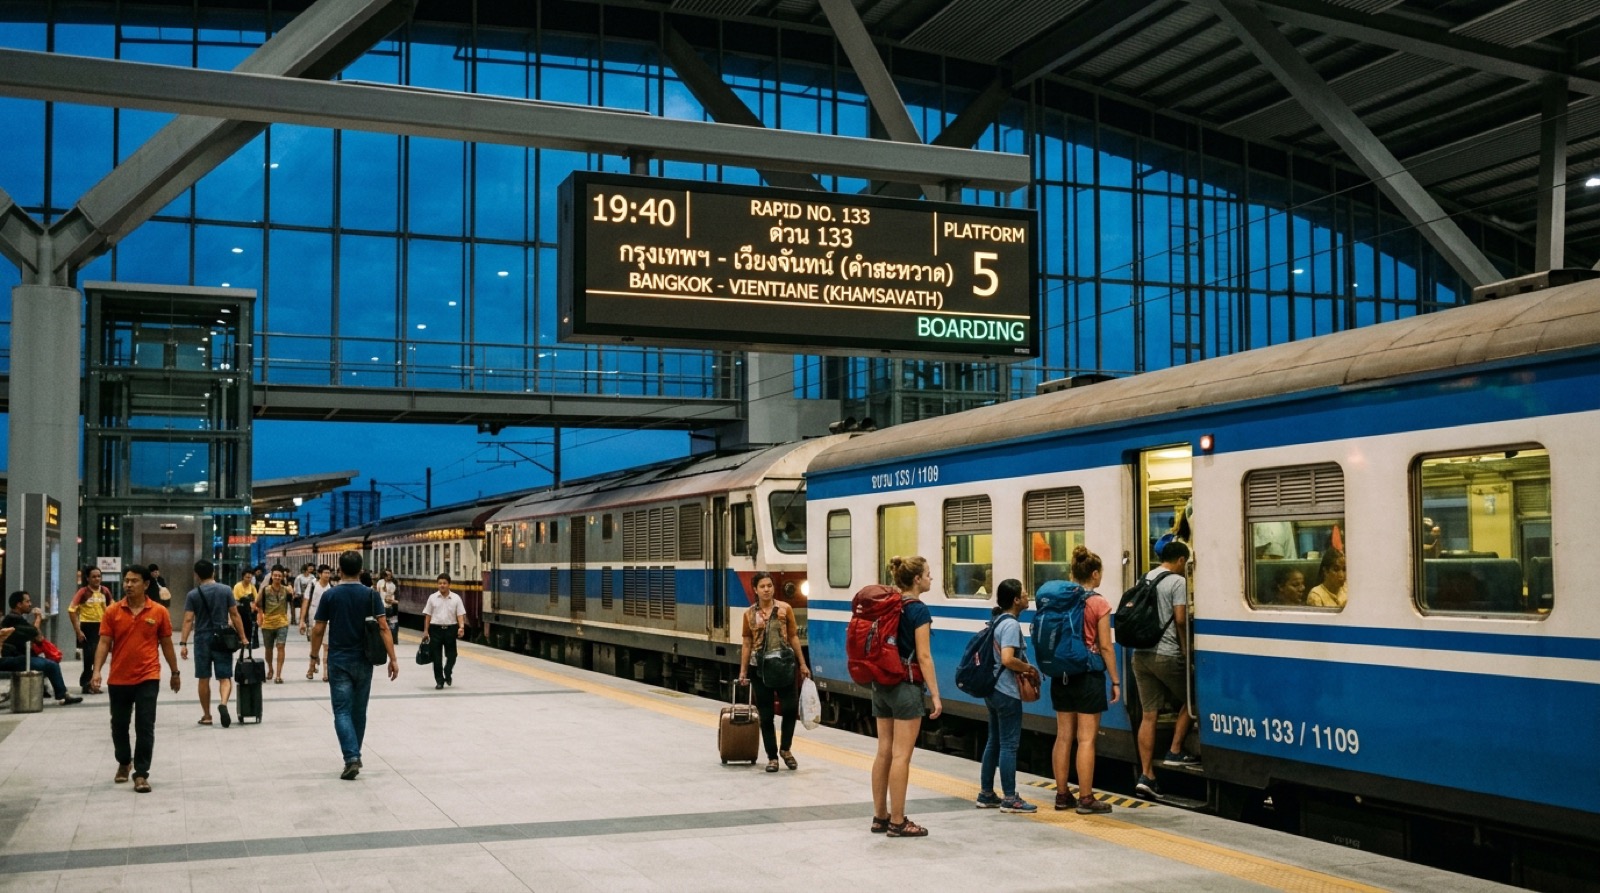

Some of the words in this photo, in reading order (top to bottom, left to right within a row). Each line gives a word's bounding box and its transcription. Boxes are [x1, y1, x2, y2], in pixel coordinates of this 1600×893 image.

[593, 193, 676, 227] 19:40
[750, 200, 802, 219] RAPID
[806, 205, 837, 222] NO.
[842, 207, 871, 225] 133
[769, 219, 810, 245] ด่วน
[817, 226, 853, 249] 133
[943, 222, 1025, 243] PLATFORM
[619, 244, 710, 271] กรุงเทพฯ
[734, 244, 834, 276] เวียงจันทน์
[840, 253, 954, 288] (คำสะทวาด)
[972, 251, 999, 297] 5
[628, 272, 713, 294] BANGKOK
[728, 278, 820, 300] VIENTIANE
[822, 284, 944, 310] (KHAMSAVATH)
[917, 316, 1025, 342] BOARDING
[1210, 712, 1257, 738] ขบวน
[1262, 717, 1294, 744] 133
[1299, 721, 1306, 747] /
[1312, 723, 1360, 755] 1109
